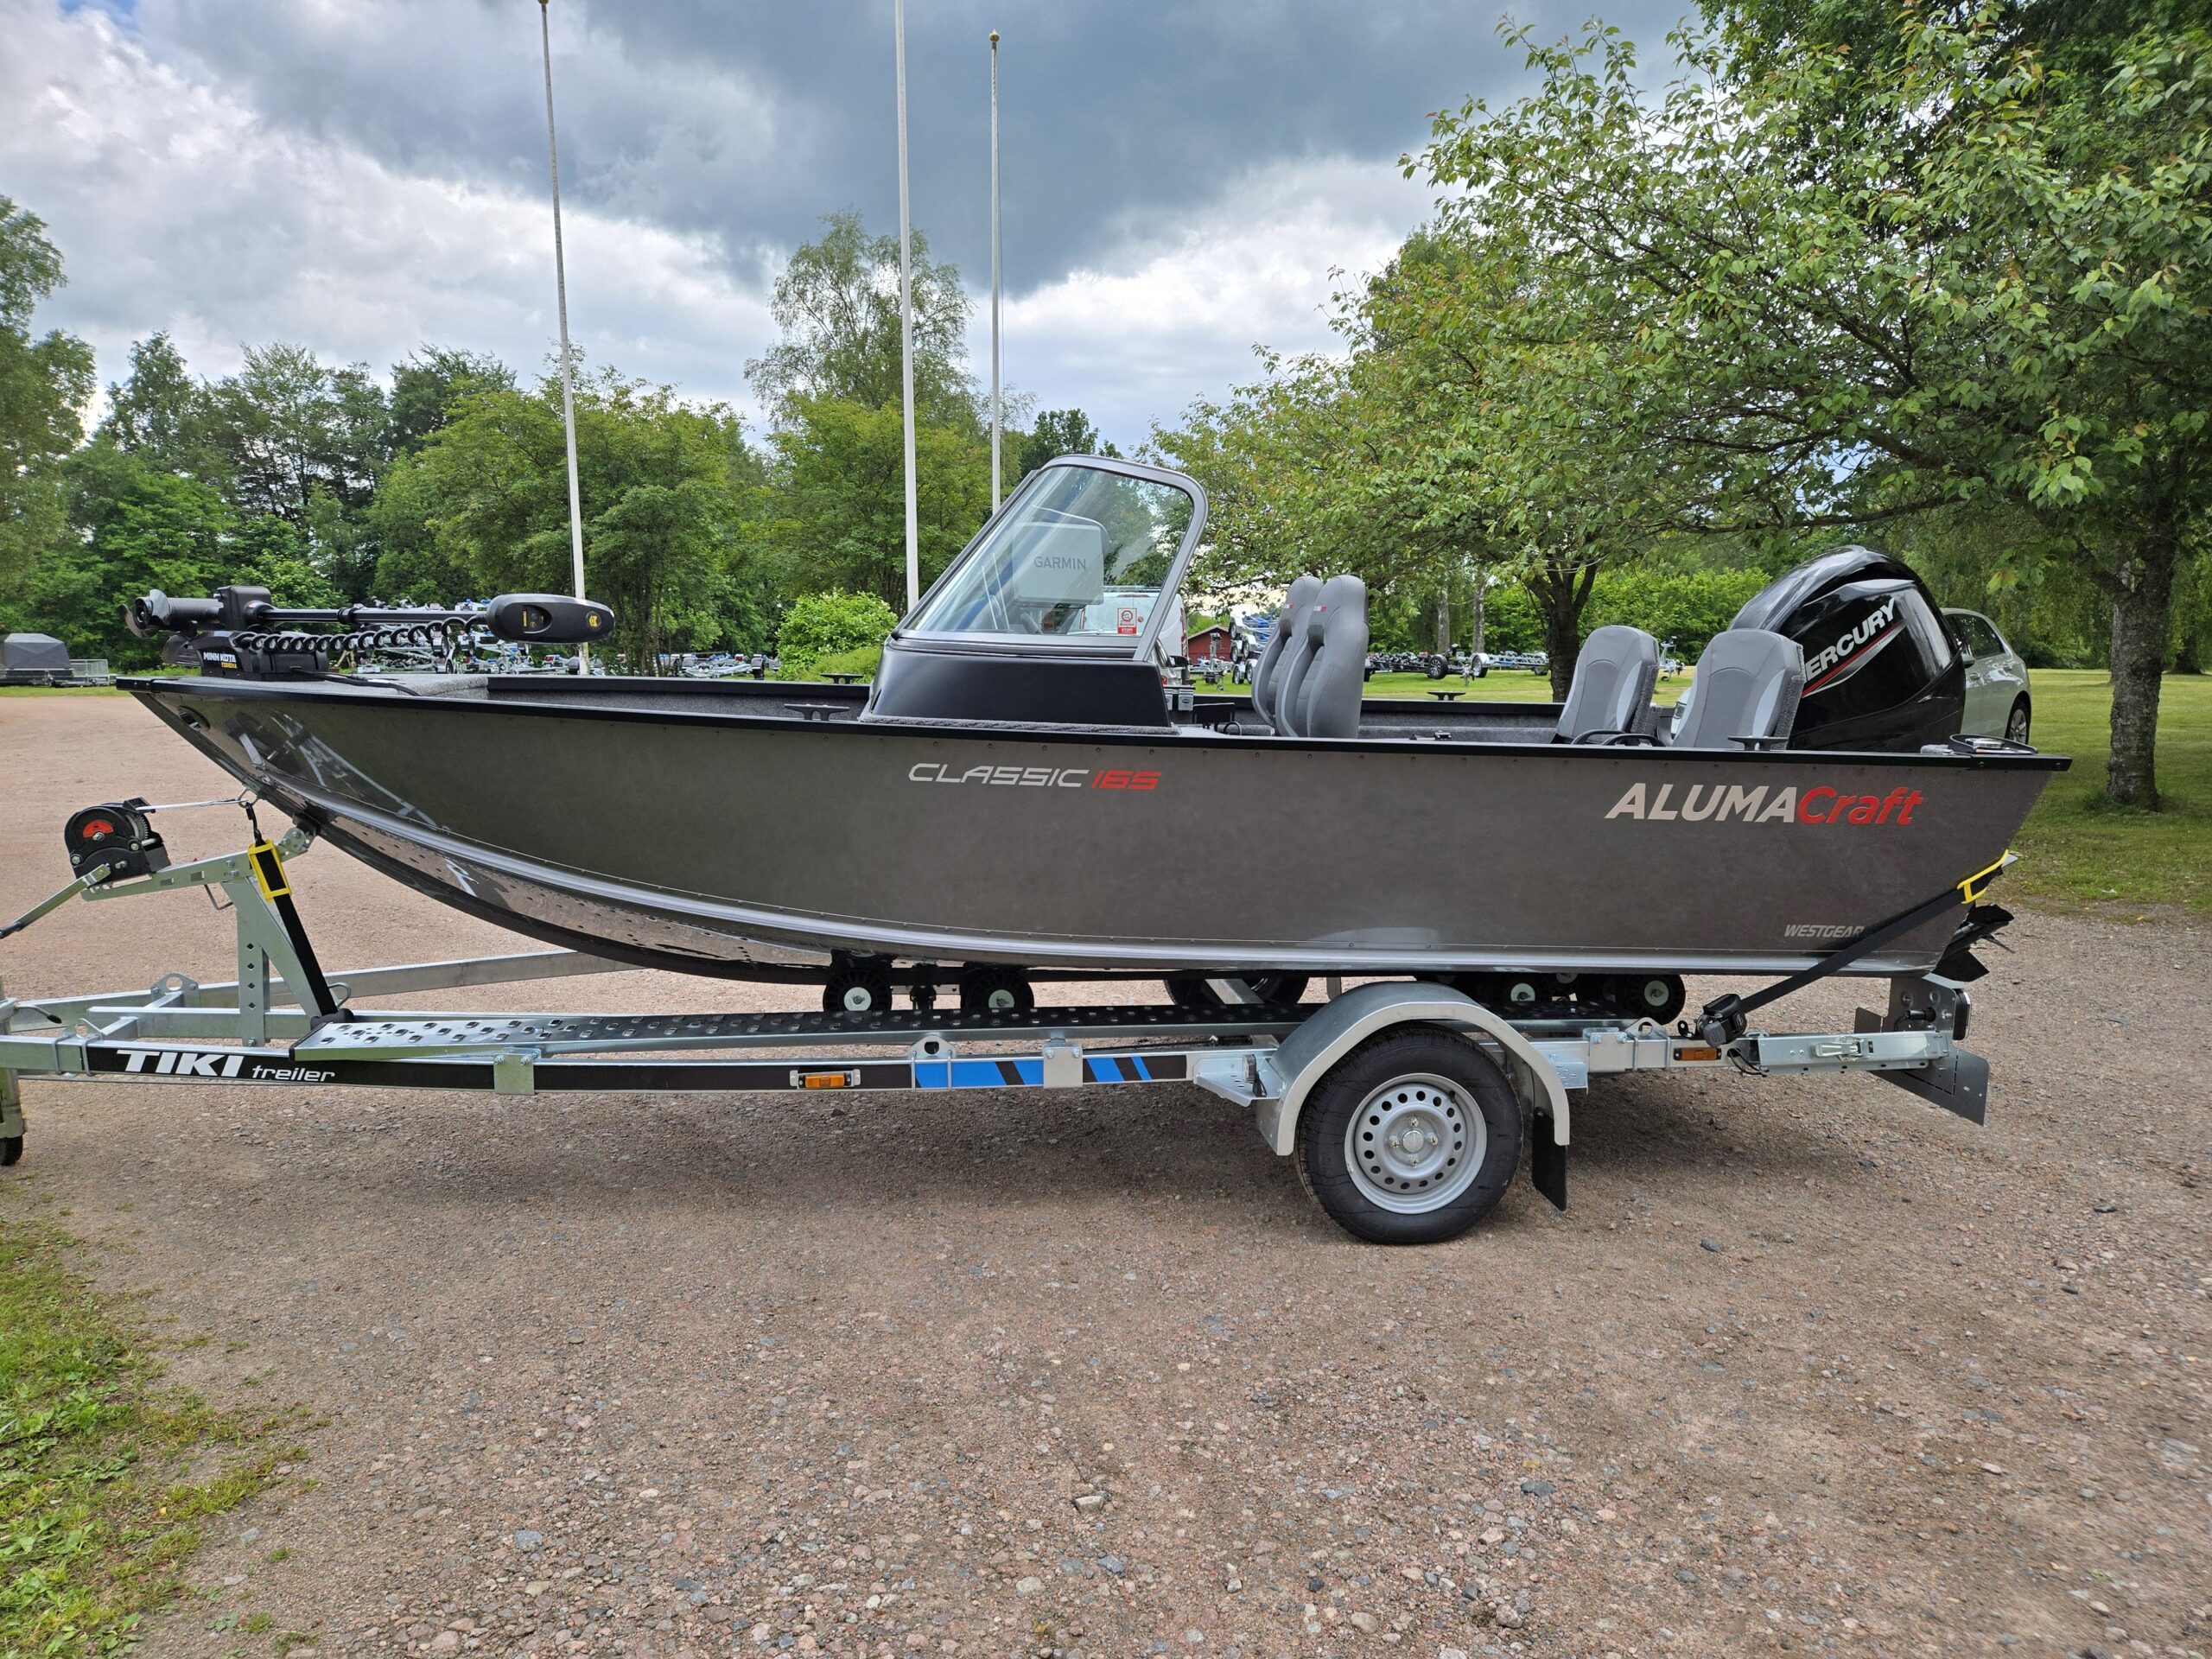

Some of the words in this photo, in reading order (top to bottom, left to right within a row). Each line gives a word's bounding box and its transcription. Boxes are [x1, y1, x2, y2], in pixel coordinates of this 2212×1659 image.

[1033, 556, 1086, 570] GARMIN
[1805, 595, 1895, 681] ERCURY
[203, 652, 219, 661] MINN
[219, 653, 237, 663] KOTA
[908, 763, 1090, 787] CLASSIC
[1091, 770, 1162, 790] 165
[1604, 782, 1923, 825] ALUMACraft
[1784, 924, 1865, 938] WESTGEAR
[117, 1049, 245, 1077] TIKI
[251, 1065, 335, 1083] treiler
